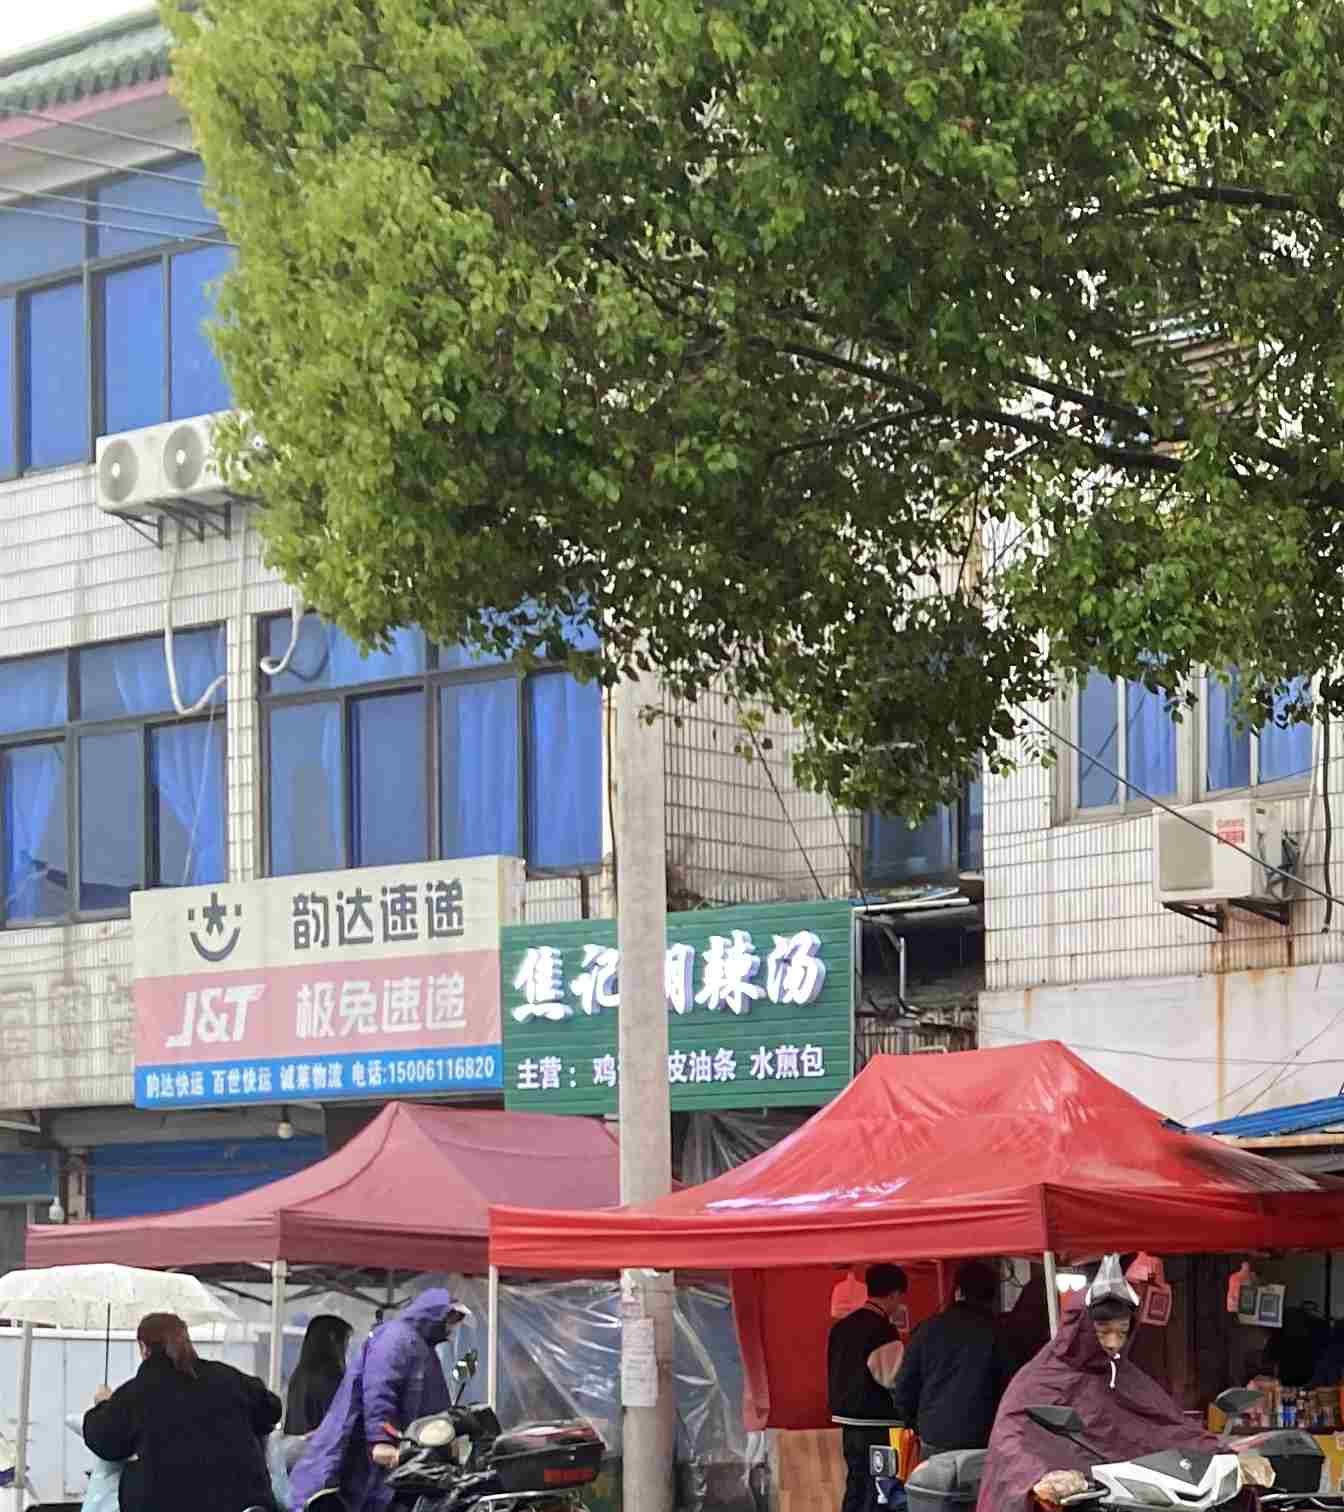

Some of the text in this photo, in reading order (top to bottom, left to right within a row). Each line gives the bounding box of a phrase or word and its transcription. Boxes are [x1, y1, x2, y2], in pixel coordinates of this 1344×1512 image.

[292, 879, 465, 950] 韵达速递
[164, 983, 267, 1049] J&T
[295, 971, 468, 1041] 极兔速递
[750, 1044, 826, 1080] 水煎包
